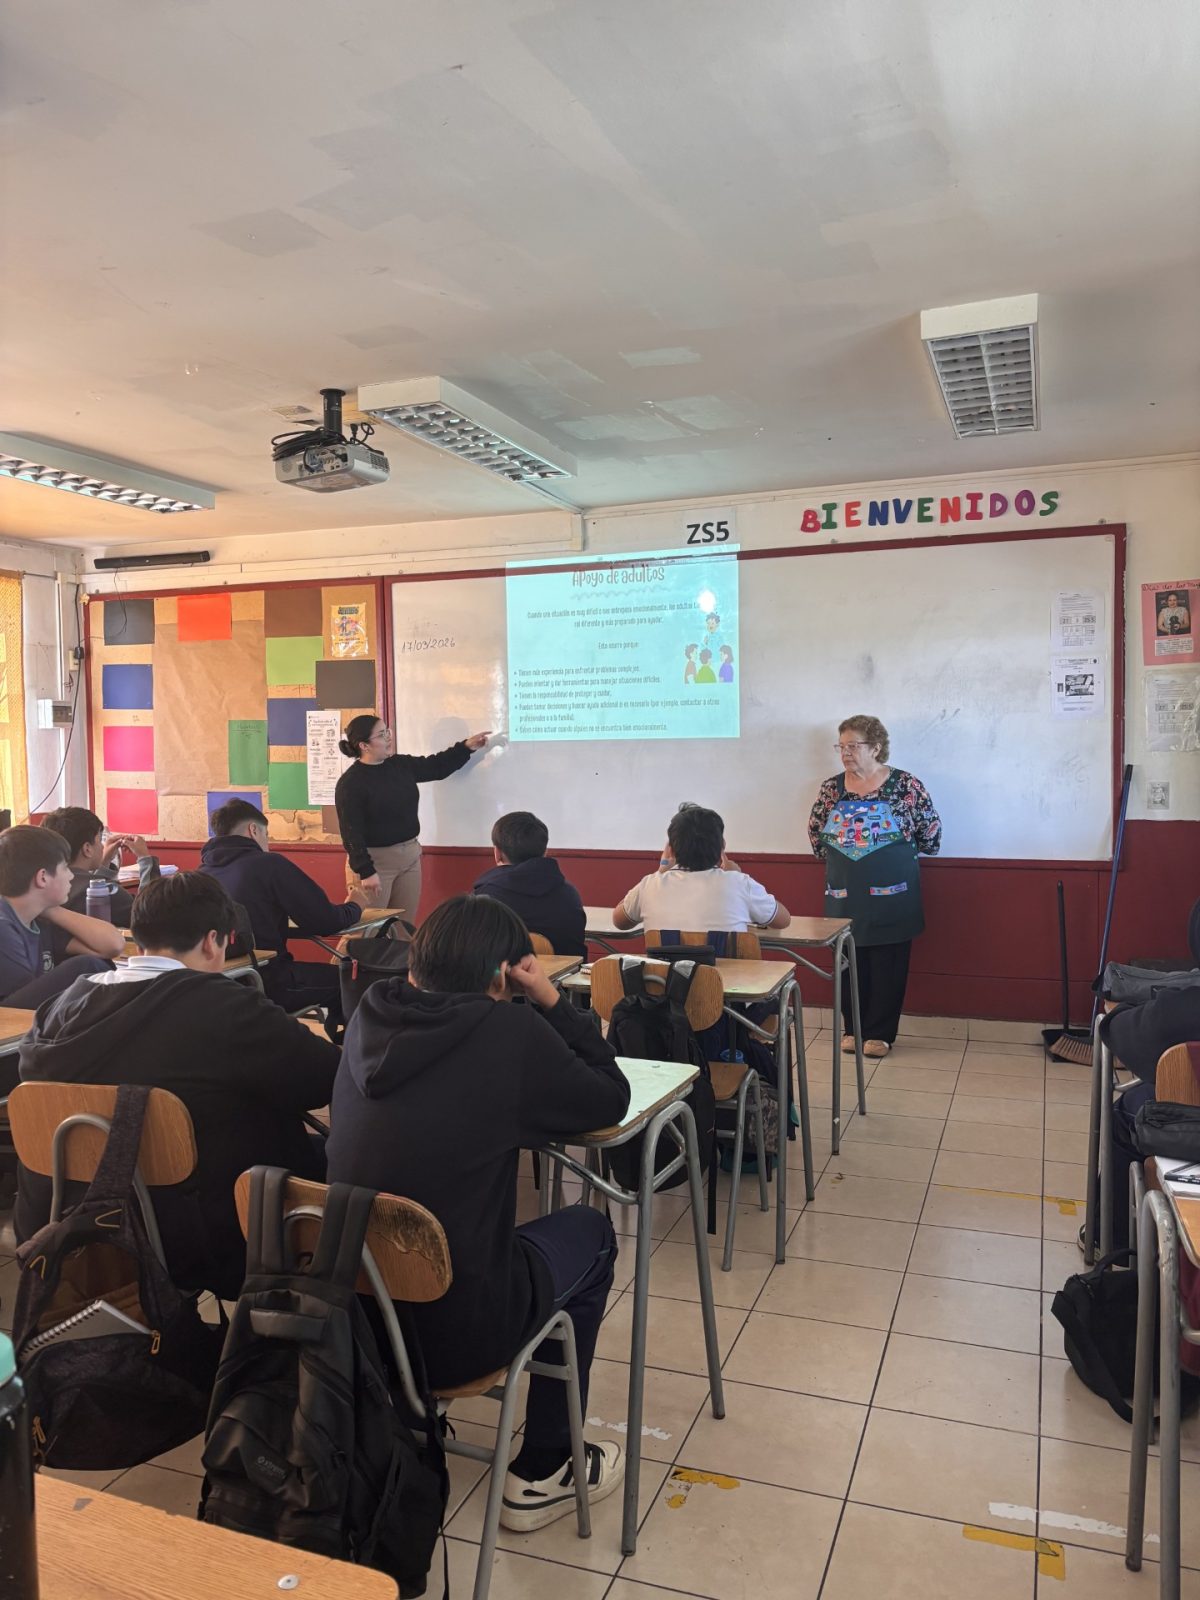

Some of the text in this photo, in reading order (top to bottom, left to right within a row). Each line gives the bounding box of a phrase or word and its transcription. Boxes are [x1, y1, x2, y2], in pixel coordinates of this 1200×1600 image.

[800, 489, 1059, 533] BIENVENIDOS
[686, 520, 730, 544] ZS5
[606, 566, 619, 584] de
[621, 564, 665, 583] adultos
[401, 636, 456, 653] 17/03/2026
